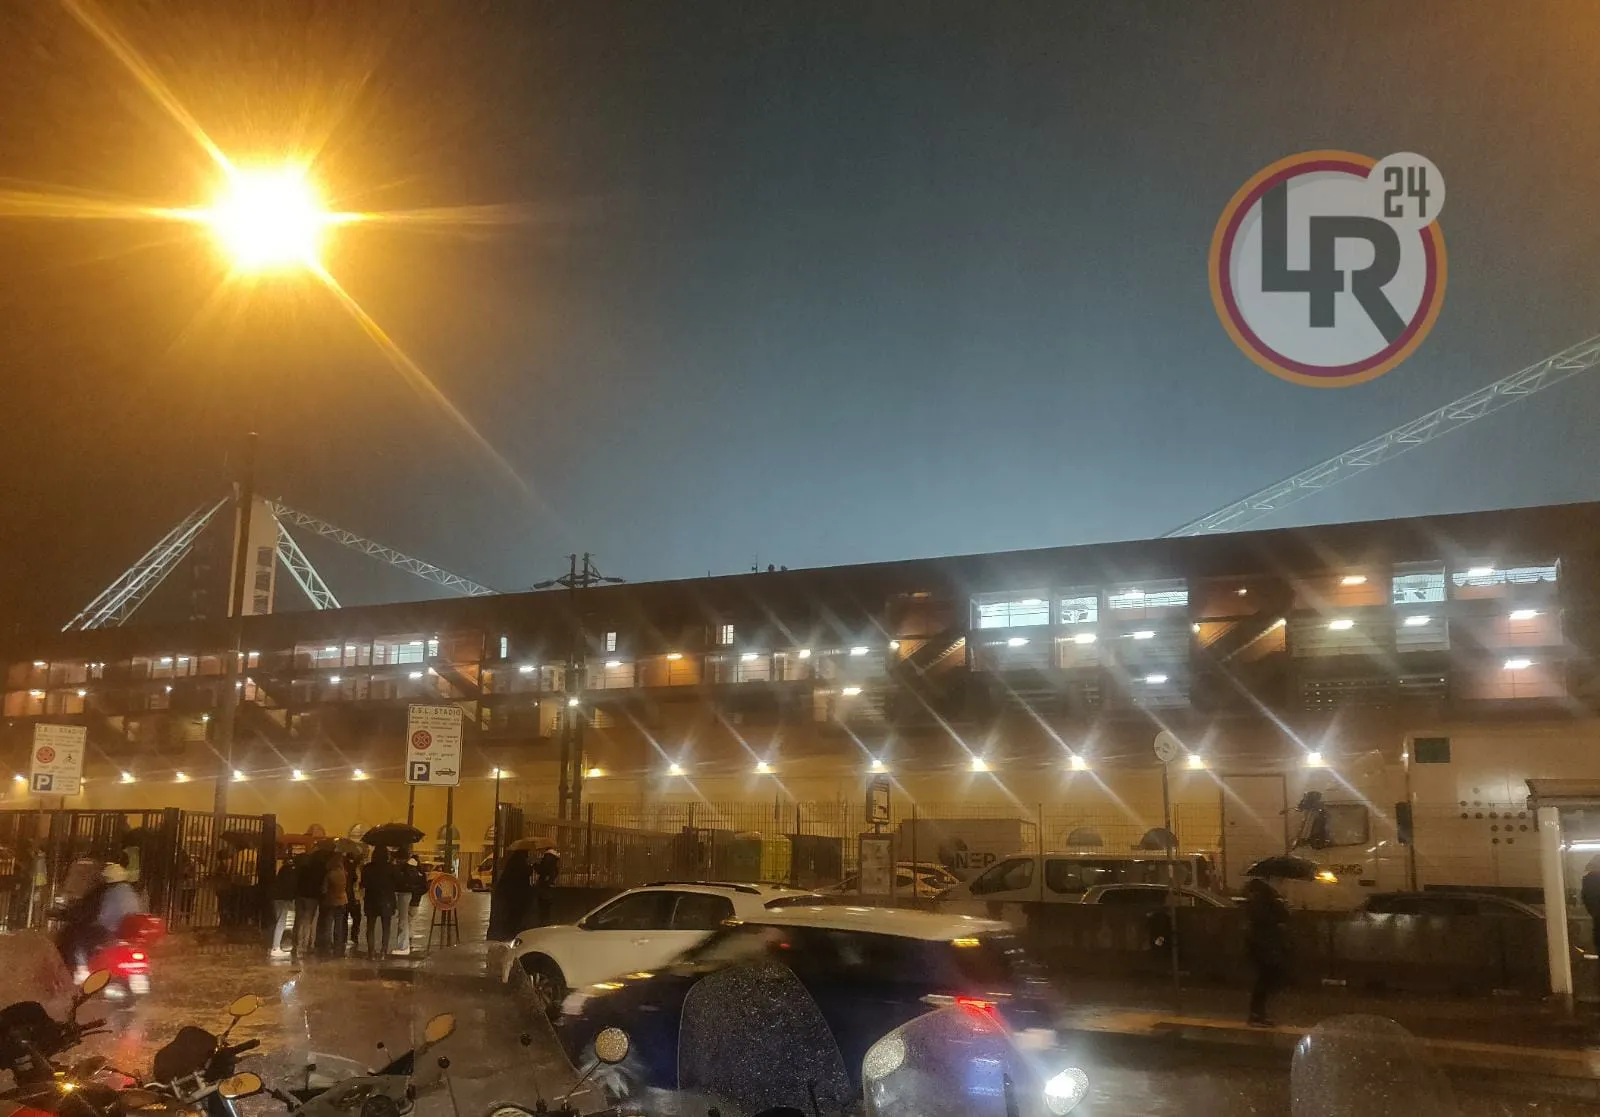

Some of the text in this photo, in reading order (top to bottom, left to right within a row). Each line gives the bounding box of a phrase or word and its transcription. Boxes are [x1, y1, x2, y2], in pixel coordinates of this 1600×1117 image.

[434, 708, 461, 716] STADIO
[413, 763, 427, 780] P
[36, 775, 50, 791] P
